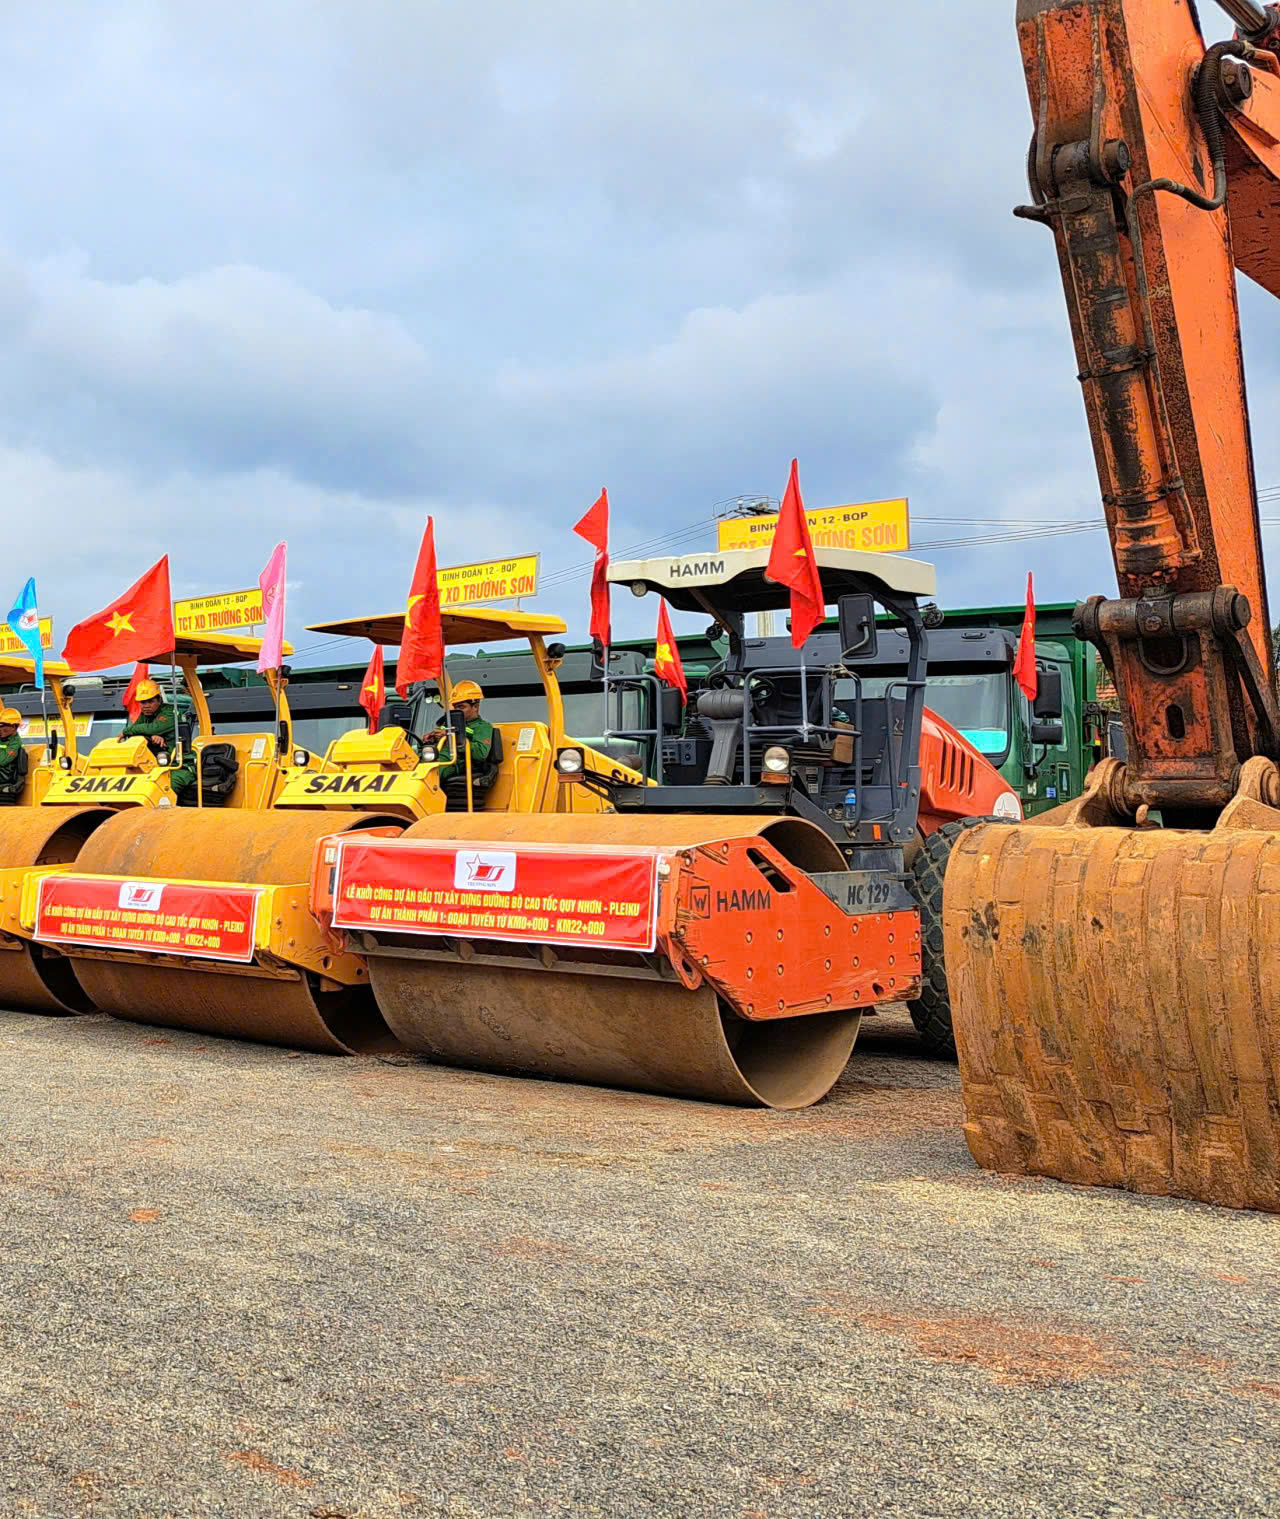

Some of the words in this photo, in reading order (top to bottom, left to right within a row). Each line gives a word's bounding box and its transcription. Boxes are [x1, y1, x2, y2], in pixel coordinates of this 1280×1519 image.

[822, 516, 834, 524] 12
[843, 512, 868, 522] BQP
[861, 523, 897, 547] SƠN
[485, 566, 494, 575] 12
[502, 563, 517, 573] BQP
[670, 560, 725, 578] HAMM
[464, 578, 507, 601] TRƯỜNG
[510, 574, 534, 594] SƠN
[178, 616, 192, 632] TCT
[208, 607, 241, 627] TRƯỜNG
[244, 605, 262, 623] SƠN
[65, 777, 137, 793] SAKAI
[304, 774, 398, 794] SAKAI
[373, 885, 393, 901] CÔNG
[394, 888, 405, 904] DỰ
[406, 886, 416, 902] ÁN
[434, 890, 445, 904] TƯ
[524, 897, 540, 911] CAO
[542, 892, 558, 911] TỐC
[560, 899, 576, 913] QUY
[577, 899, 602, 914] NHƠN
[609, 902, 640, 916] PLEIKU
[716, 889, 771, 912] HAMM
[847, 885, 863, 905] HC
[868, 884, 890, 903] 129
[370, 906, 381, 921] DỰ
[439, 912, 447, 924] 1:
[497, 912, 507, 928] TỪ
[556, 919, 605, 935] KM22+000
